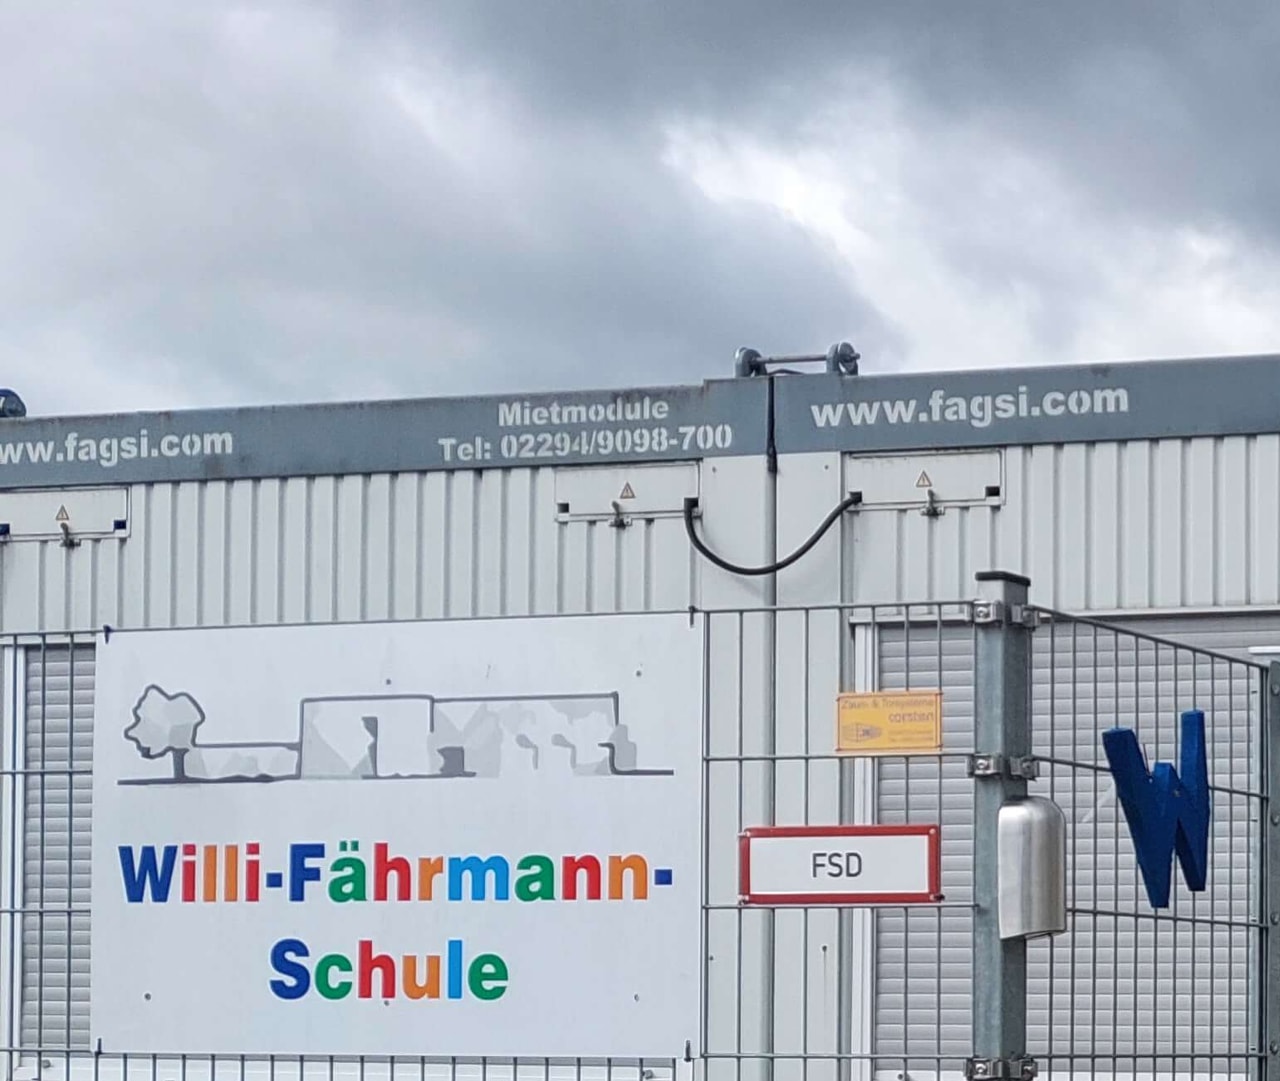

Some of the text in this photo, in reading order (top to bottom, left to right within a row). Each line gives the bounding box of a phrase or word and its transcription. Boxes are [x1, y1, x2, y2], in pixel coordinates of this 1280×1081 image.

[499, 397, 669, 427] Mietmodule
[811, 385, 1129, 428] www.fagsi.com
[438, 424, 733, 462] Tel: 02294/9098-700
[1102, 709, 1210, 909] W
[118, 840, 674, 903] Willi-Fährmann-
[812, 852, 862, 878] FSD
[269, 939, 509, 1000] Schule
